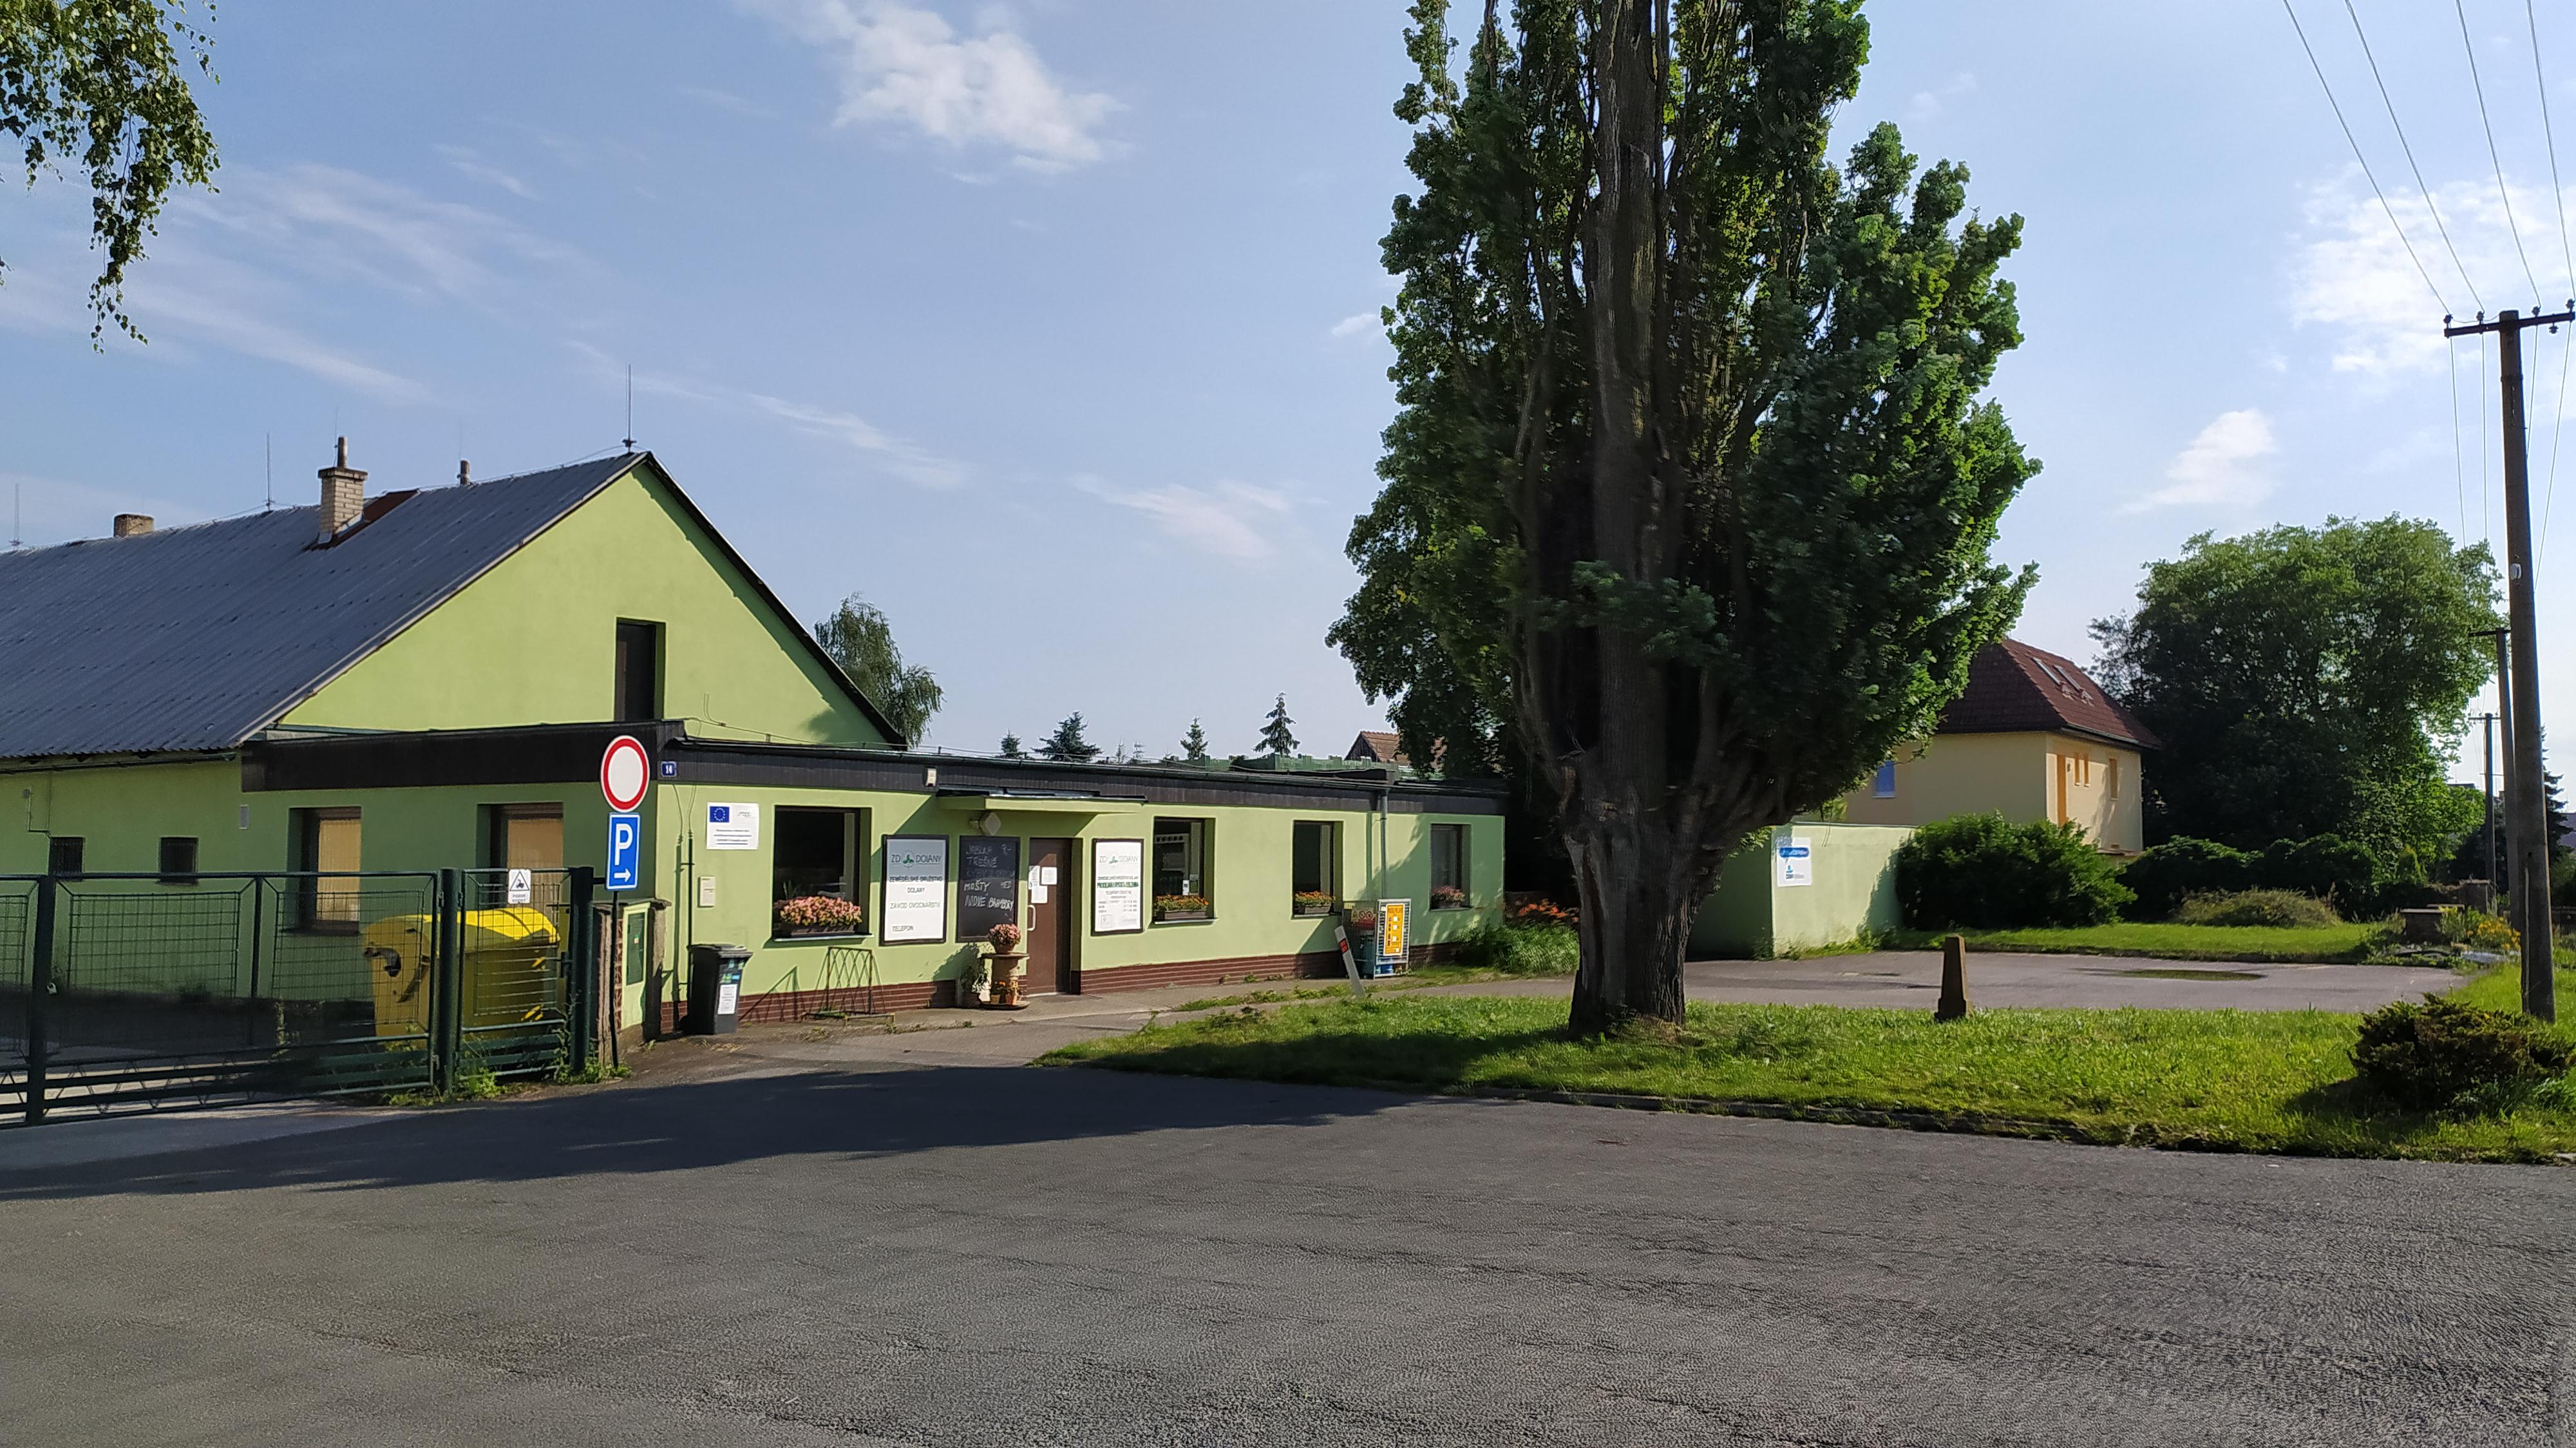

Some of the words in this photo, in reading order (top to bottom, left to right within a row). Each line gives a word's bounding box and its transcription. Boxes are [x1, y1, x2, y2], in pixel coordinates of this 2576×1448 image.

[665, 765, 673, 774] 14
[614, 823, 633, 866] P
[891, 854, 901, 863] ZD
[963, 879, 990, 892] MOŠTY
